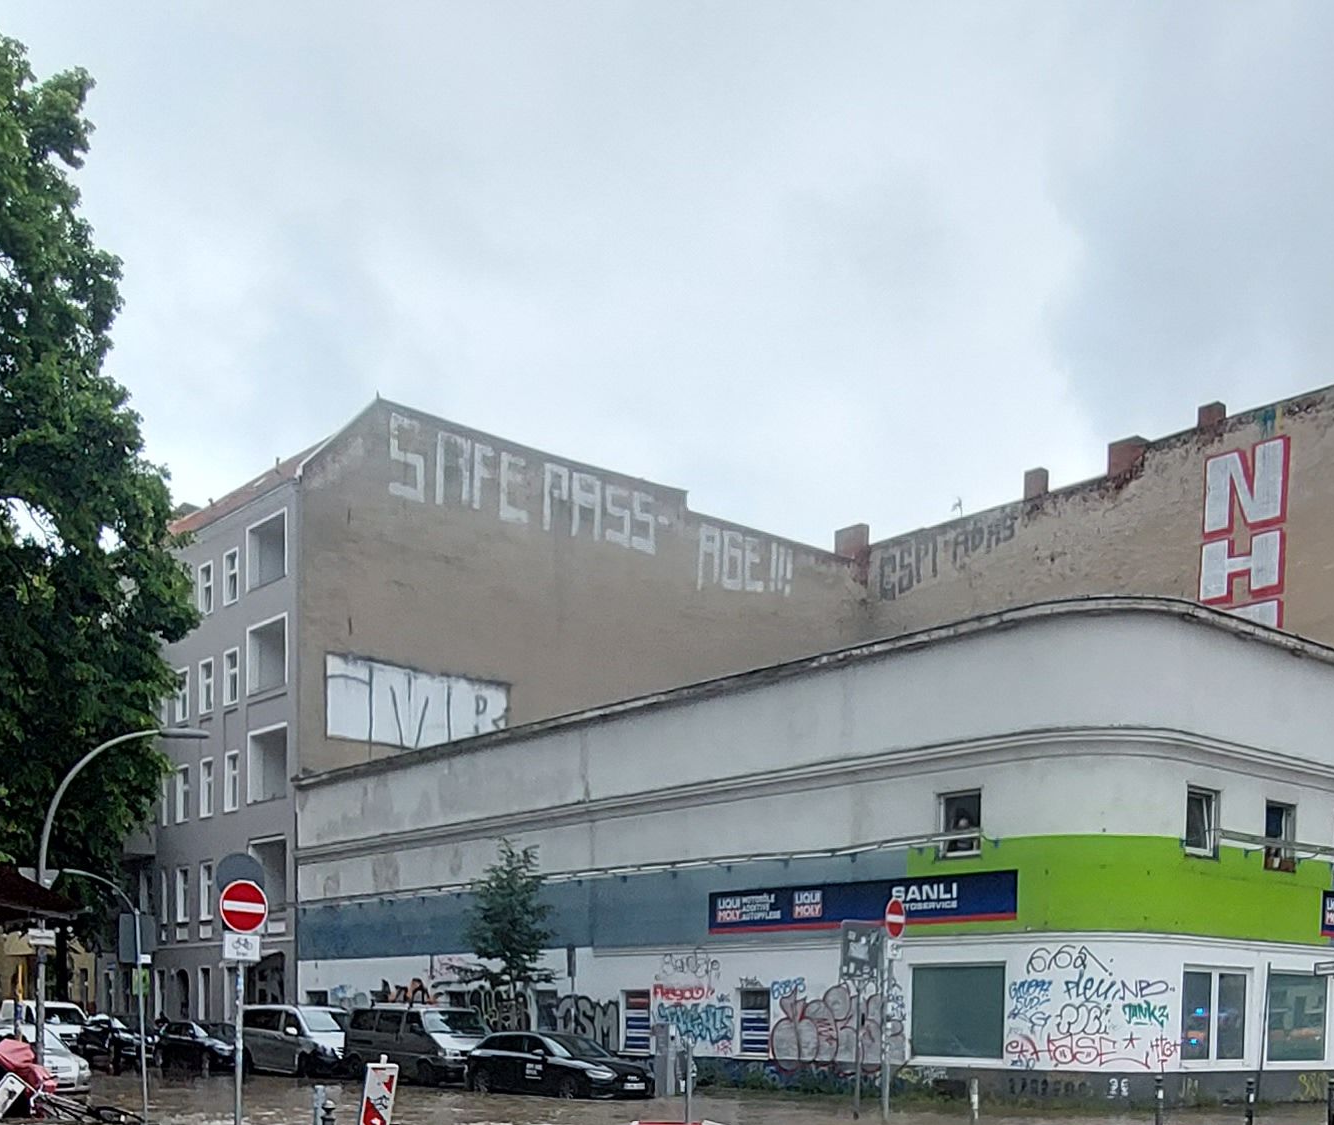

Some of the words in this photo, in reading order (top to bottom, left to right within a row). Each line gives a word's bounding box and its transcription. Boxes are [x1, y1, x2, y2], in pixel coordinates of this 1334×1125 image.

[389, 412, 529, 525] SAFE
[795, 891, 822, 904] LIQUI
[891, 882, 959, 901] SANLI
[717, 897, 741, 910] LIQUI
[717, 910, 742, 922] MOLY
[794, 904, 822, 918] MOLY
